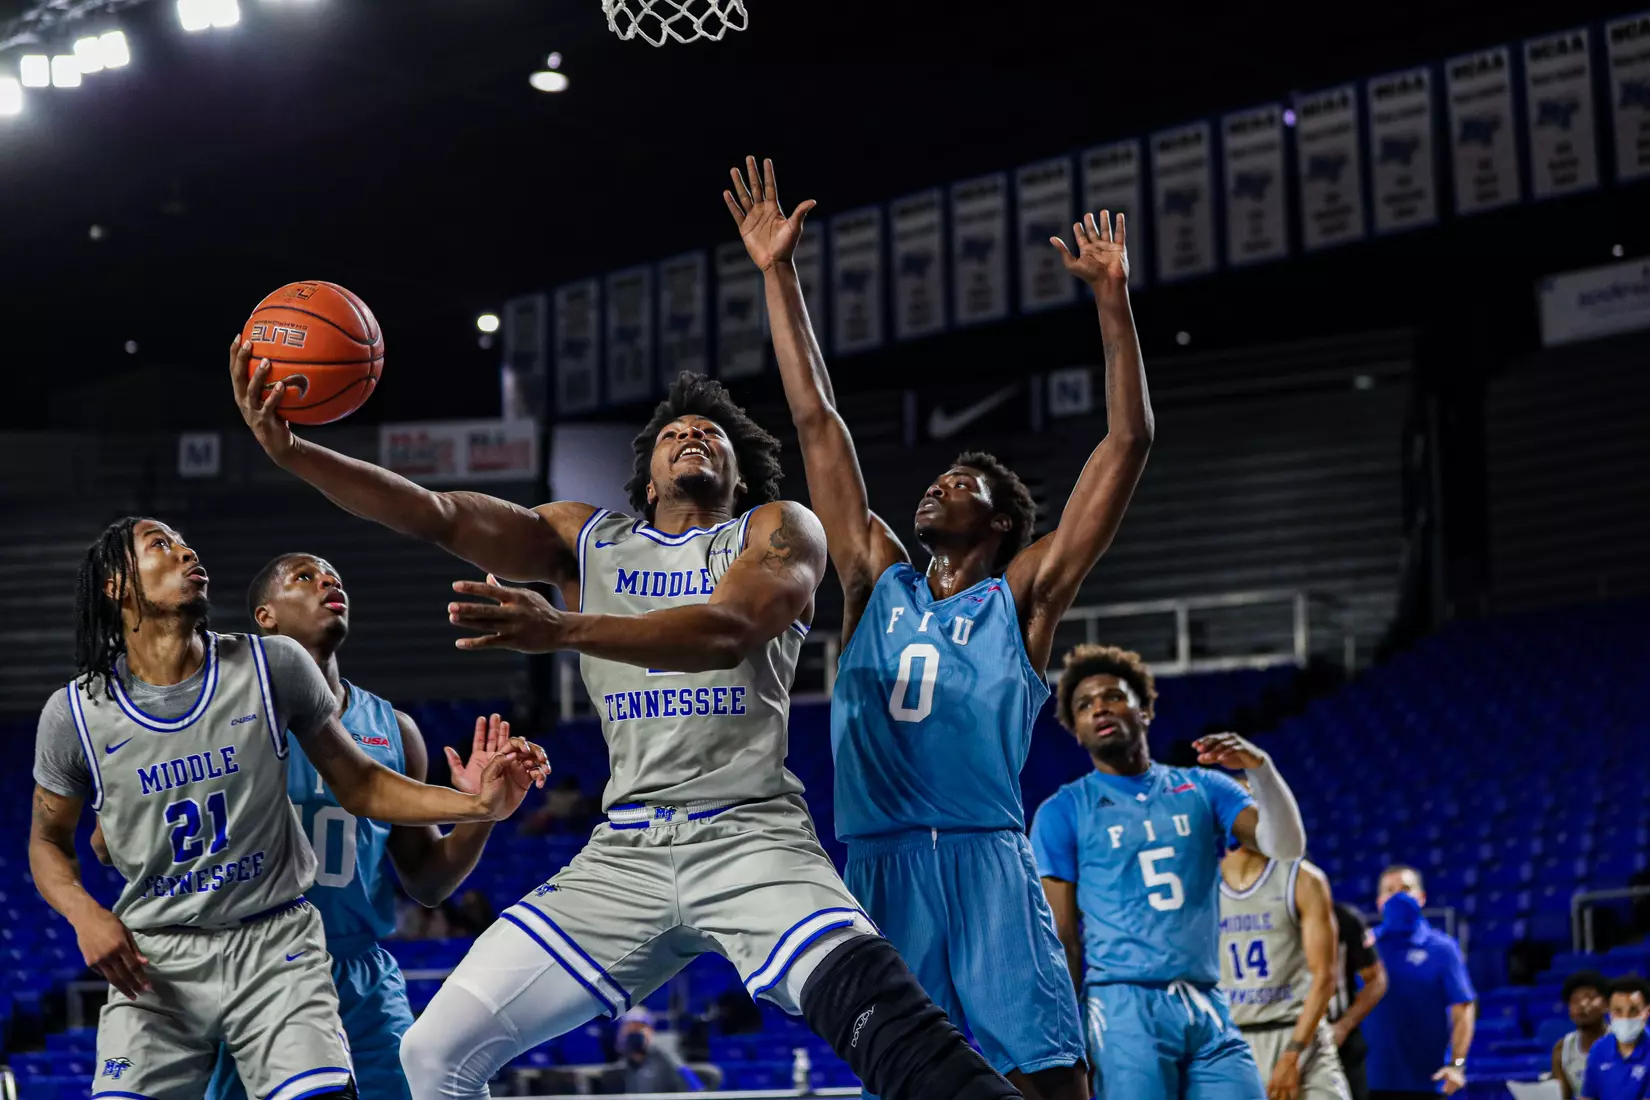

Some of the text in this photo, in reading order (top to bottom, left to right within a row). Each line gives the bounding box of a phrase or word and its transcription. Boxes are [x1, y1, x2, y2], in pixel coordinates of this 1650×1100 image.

[250, 324, 308, 349] ELITE
[1056, 380, 1082, 406] N
[188, 440, 212, 464] M
[614, 568, 715, 597] MIDDLE
[889, 643, 940, 723] 0
[604, 686, 746, 722] TENNESSEE
[137, 745, 240, 796] MIDDLE
[163, 789, 230, 866] 21
[1137, 846, 1185, 912] 5
[1228, 938, 1271, 981] 14
